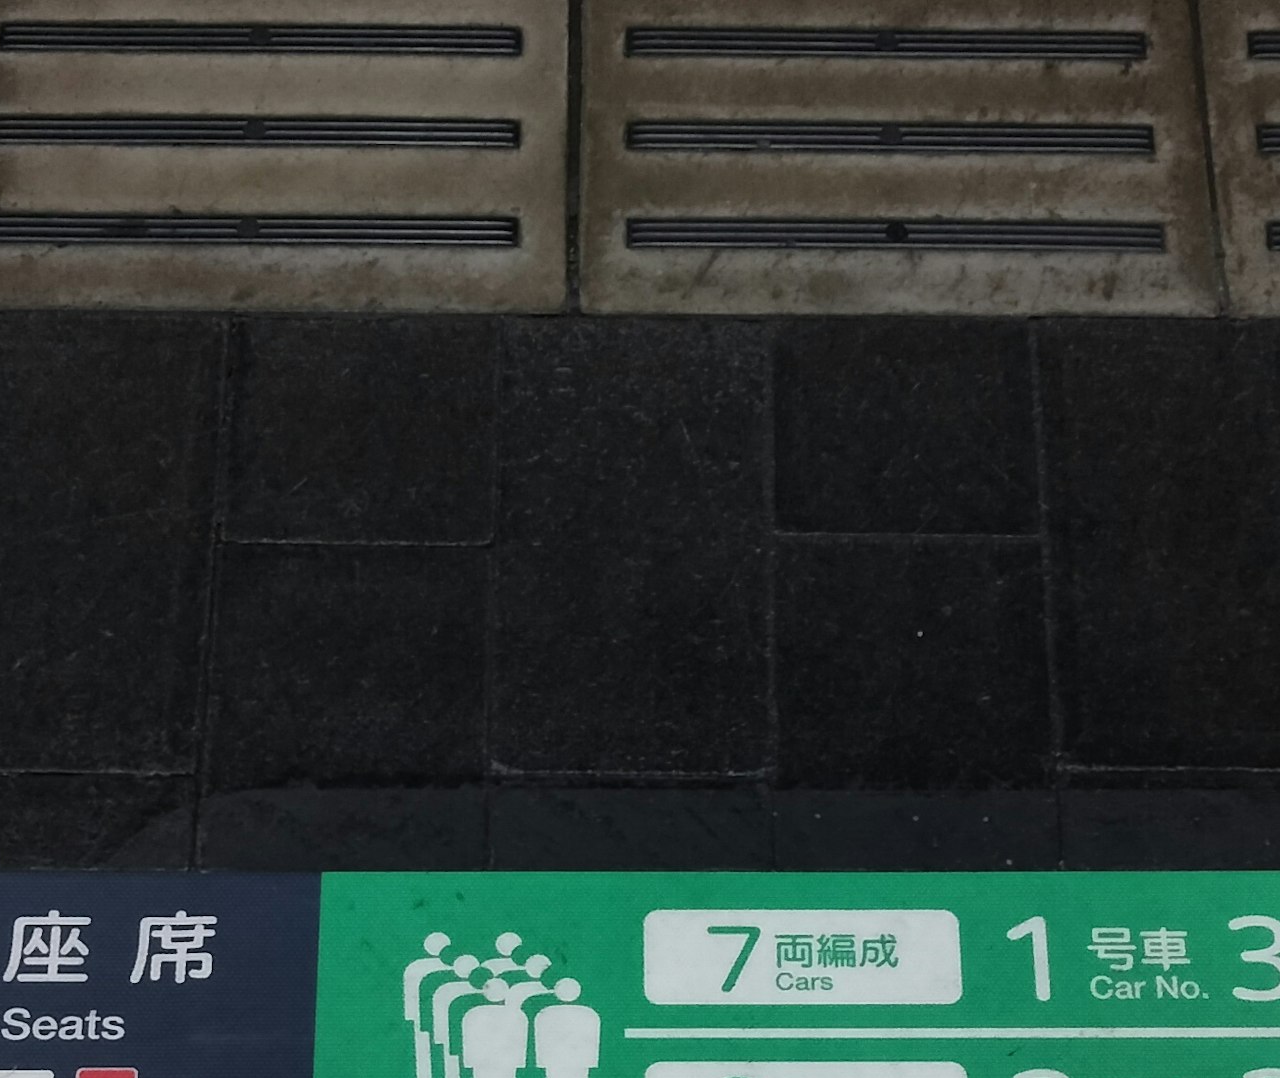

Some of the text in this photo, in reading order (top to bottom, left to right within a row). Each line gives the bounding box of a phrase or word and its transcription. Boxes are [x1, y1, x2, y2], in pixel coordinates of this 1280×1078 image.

[776, 973, 833, 990] Cars
[1090, 976, 1209, 999] Car No.
[1, 1008, 125, 1040] Seats
